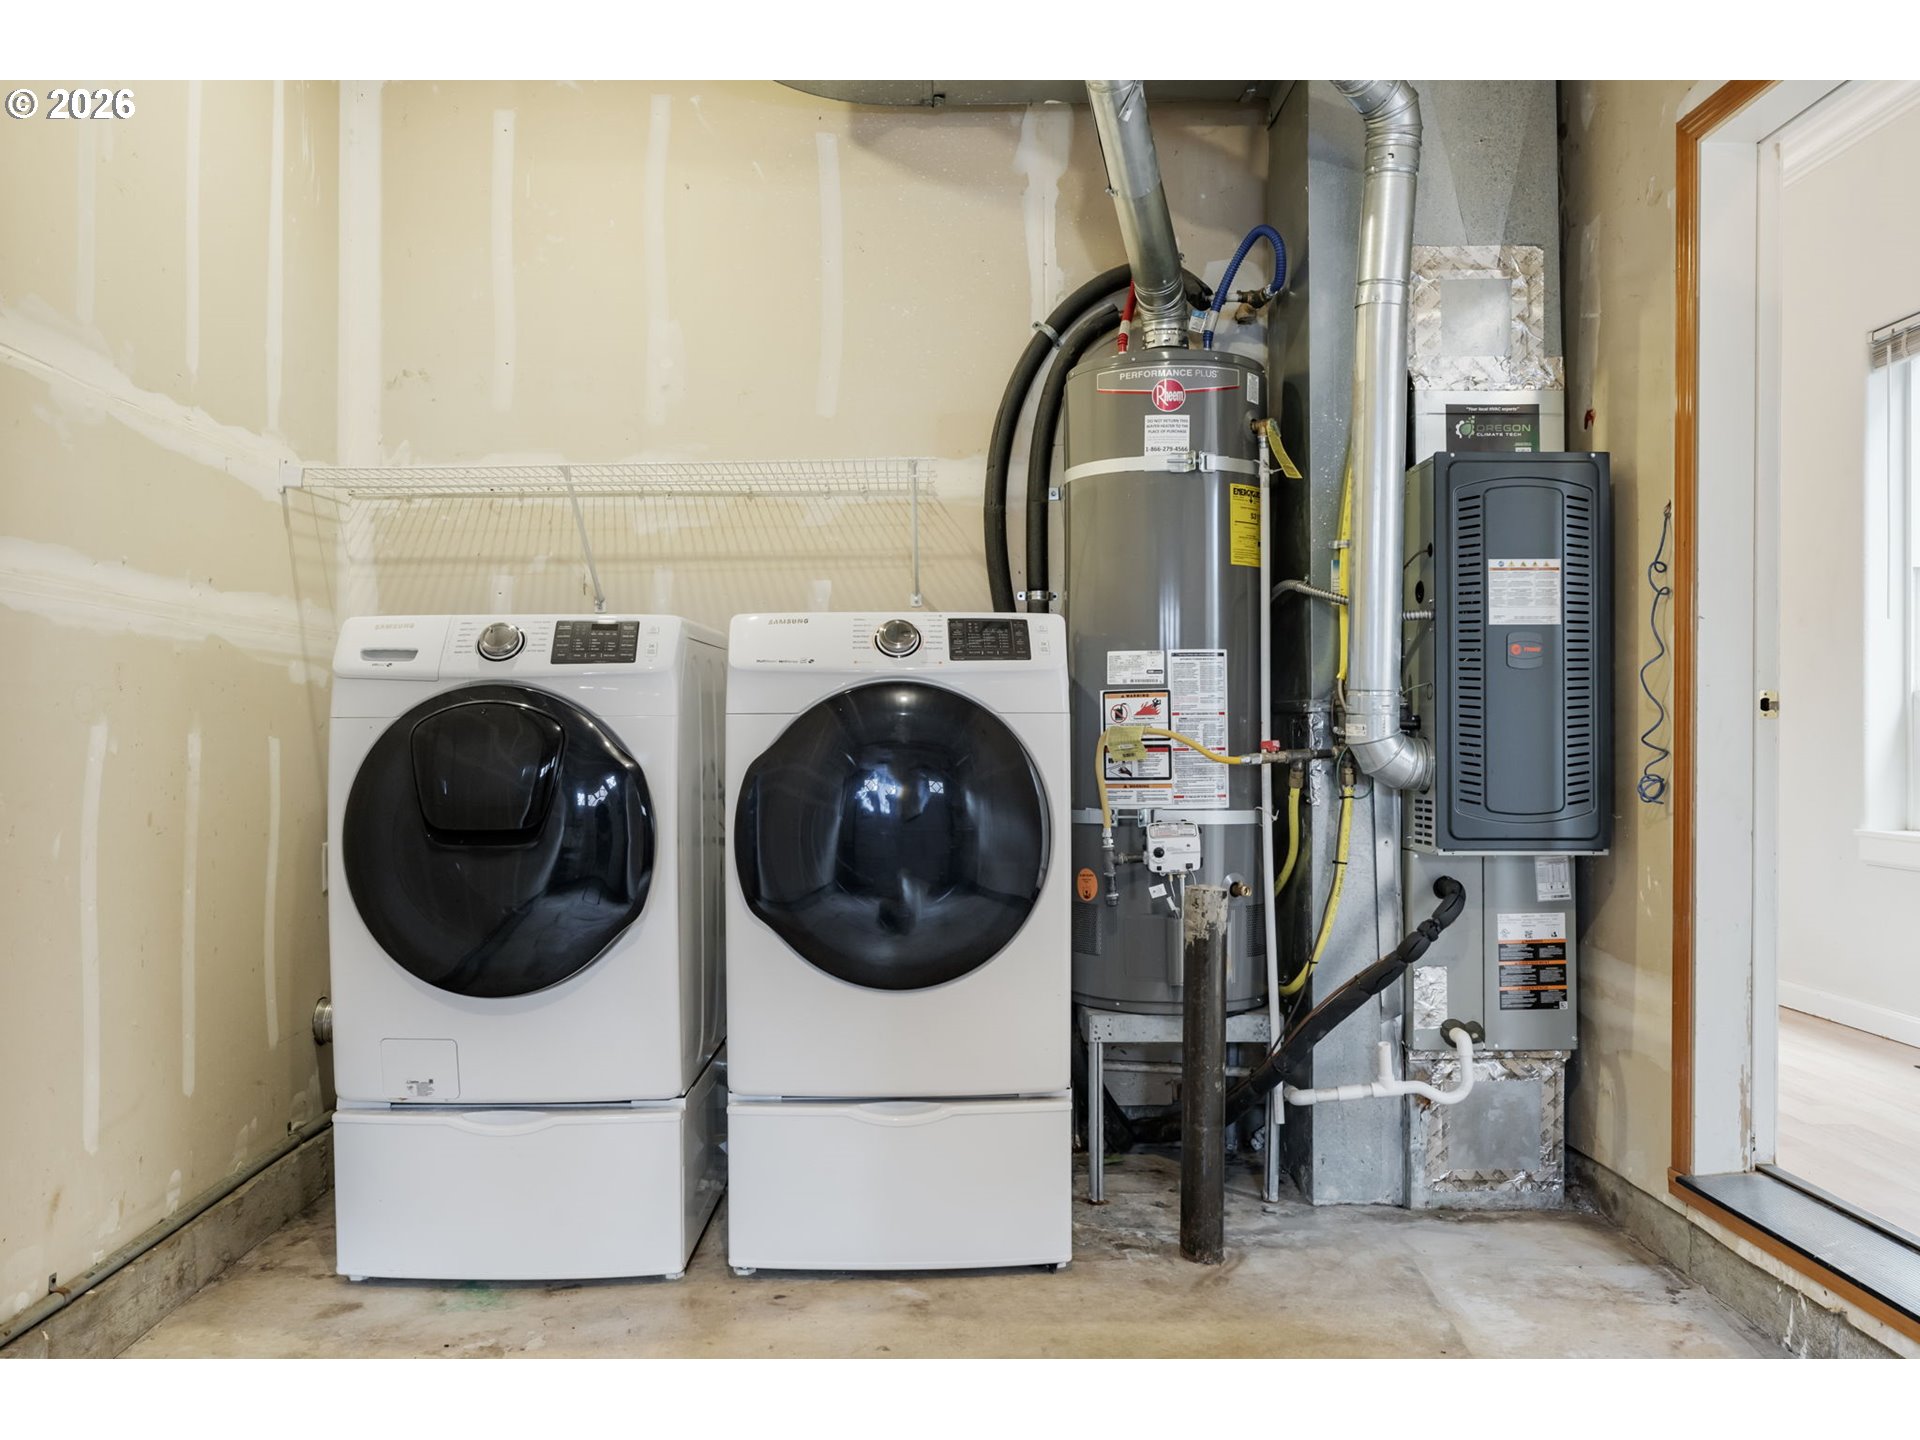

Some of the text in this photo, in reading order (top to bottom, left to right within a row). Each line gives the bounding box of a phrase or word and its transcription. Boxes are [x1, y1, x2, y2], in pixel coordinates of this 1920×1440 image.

[1119, 369, 1218, 380] PERFORMANCE PLUS
[1156, 379, 1184, 406] Rheem
[1476, 424, 1531, 432] OREGON
[375, 622, 415, 630] SAMSUNG
